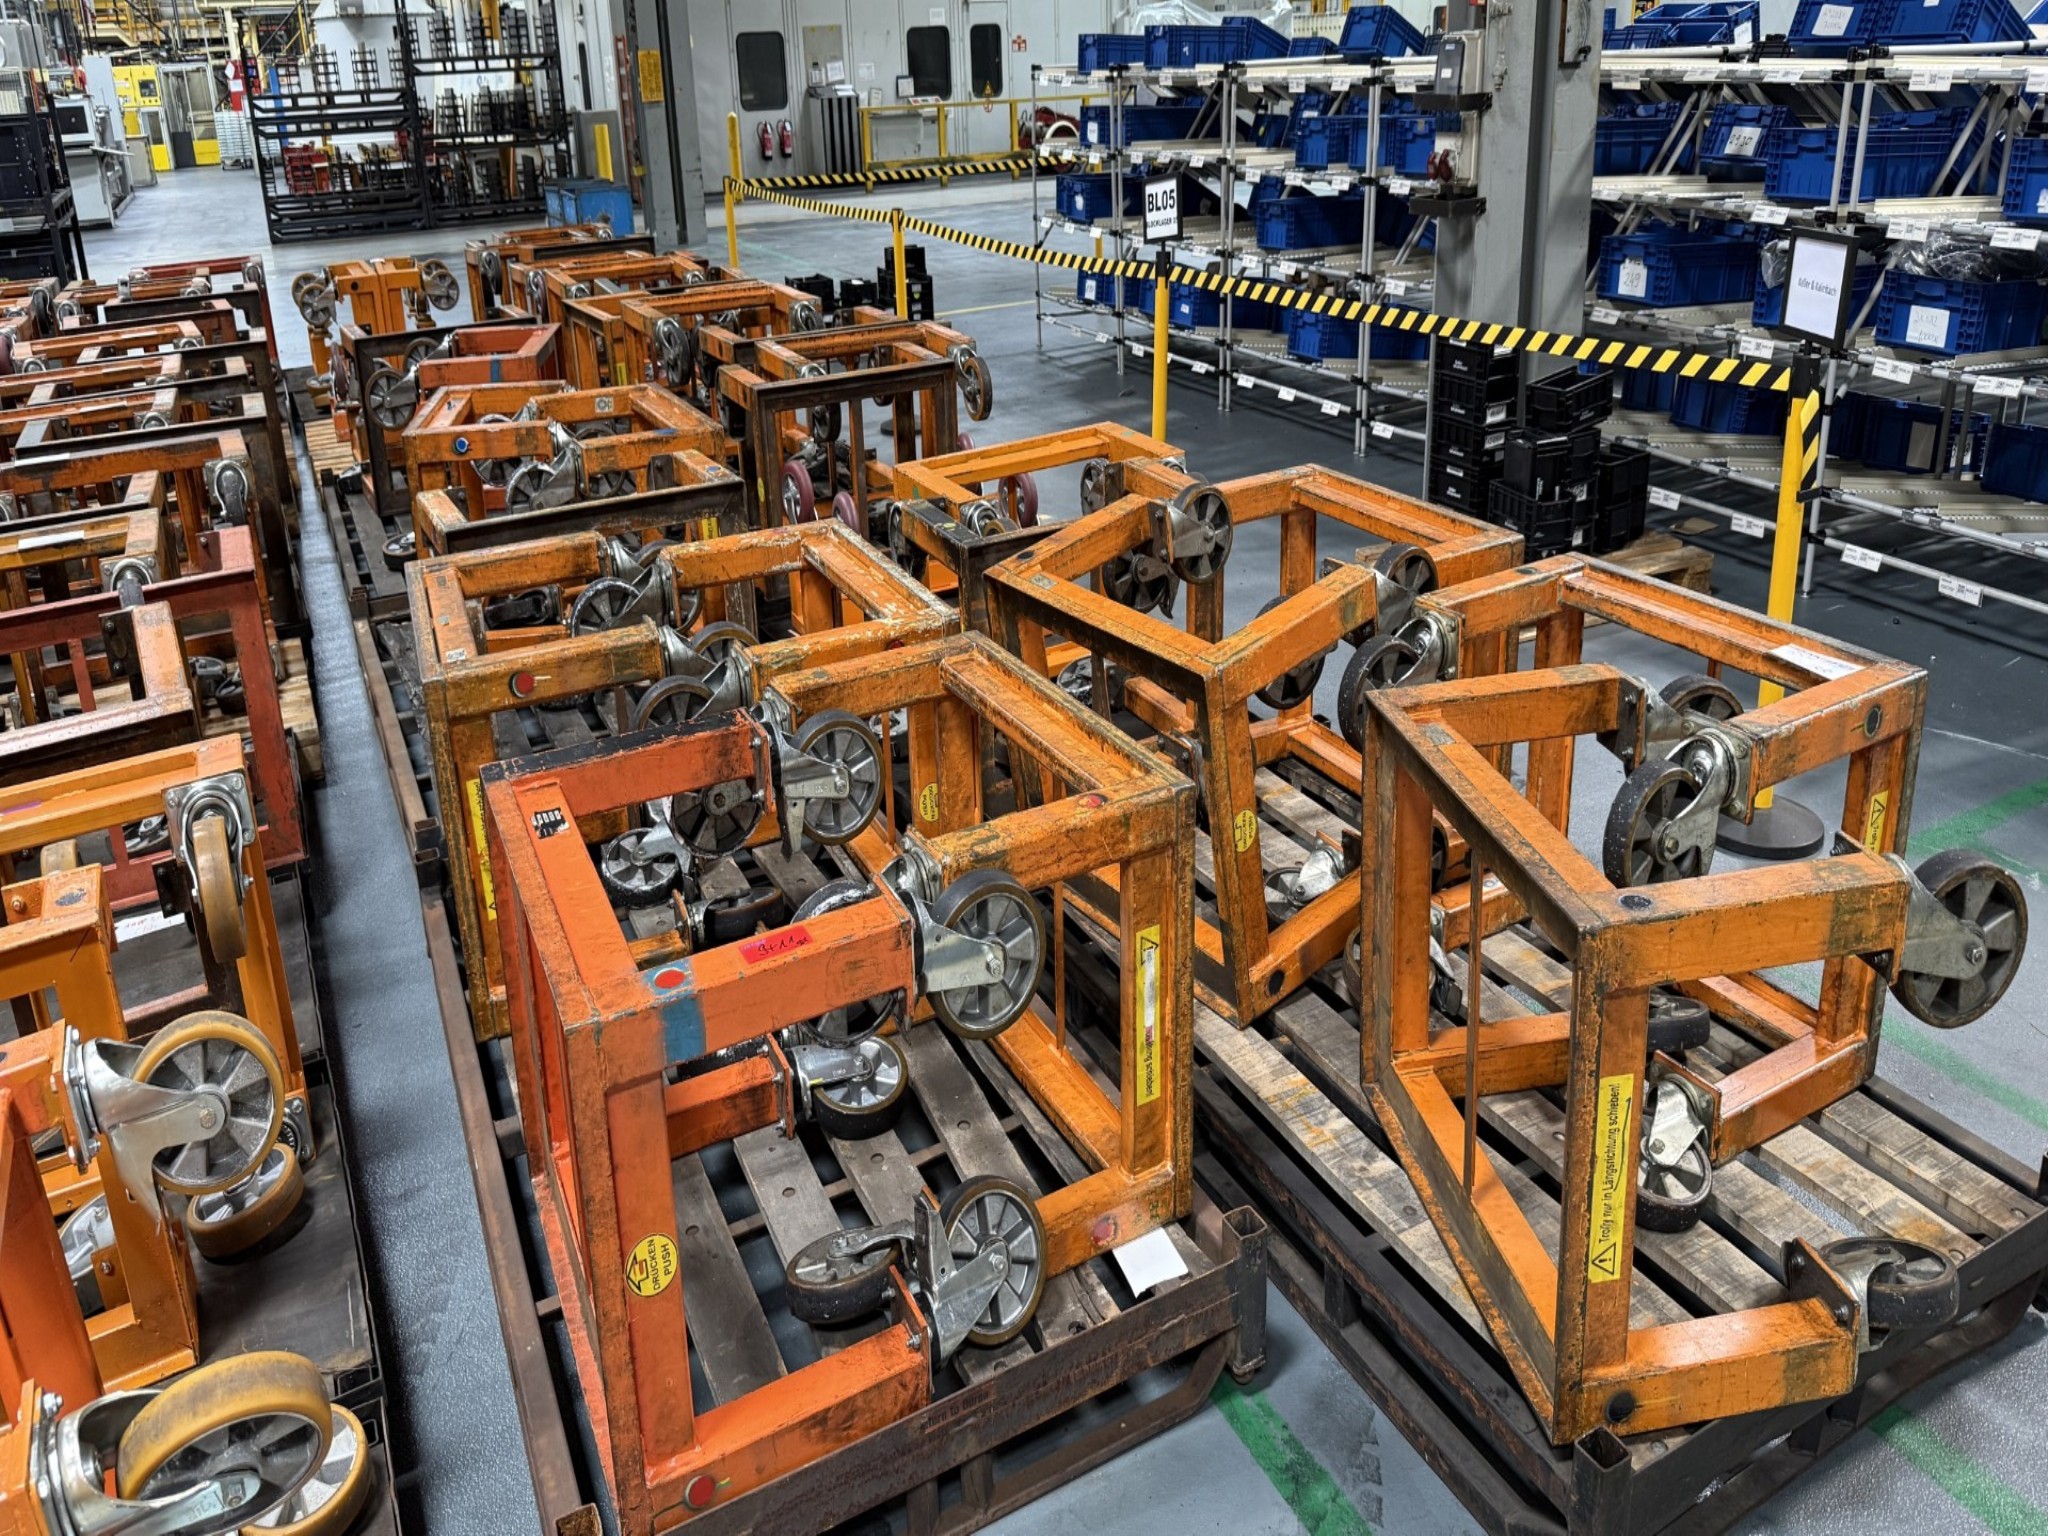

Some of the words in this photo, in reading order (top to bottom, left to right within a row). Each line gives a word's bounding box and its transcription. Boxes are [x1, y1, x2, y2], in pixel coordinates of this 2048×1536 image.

[1147, 189, 1176, 213] BL05
[647, 1239, 661, 1291] DRÜCKEN
[661, 1243, 673, 1277] PUSH
